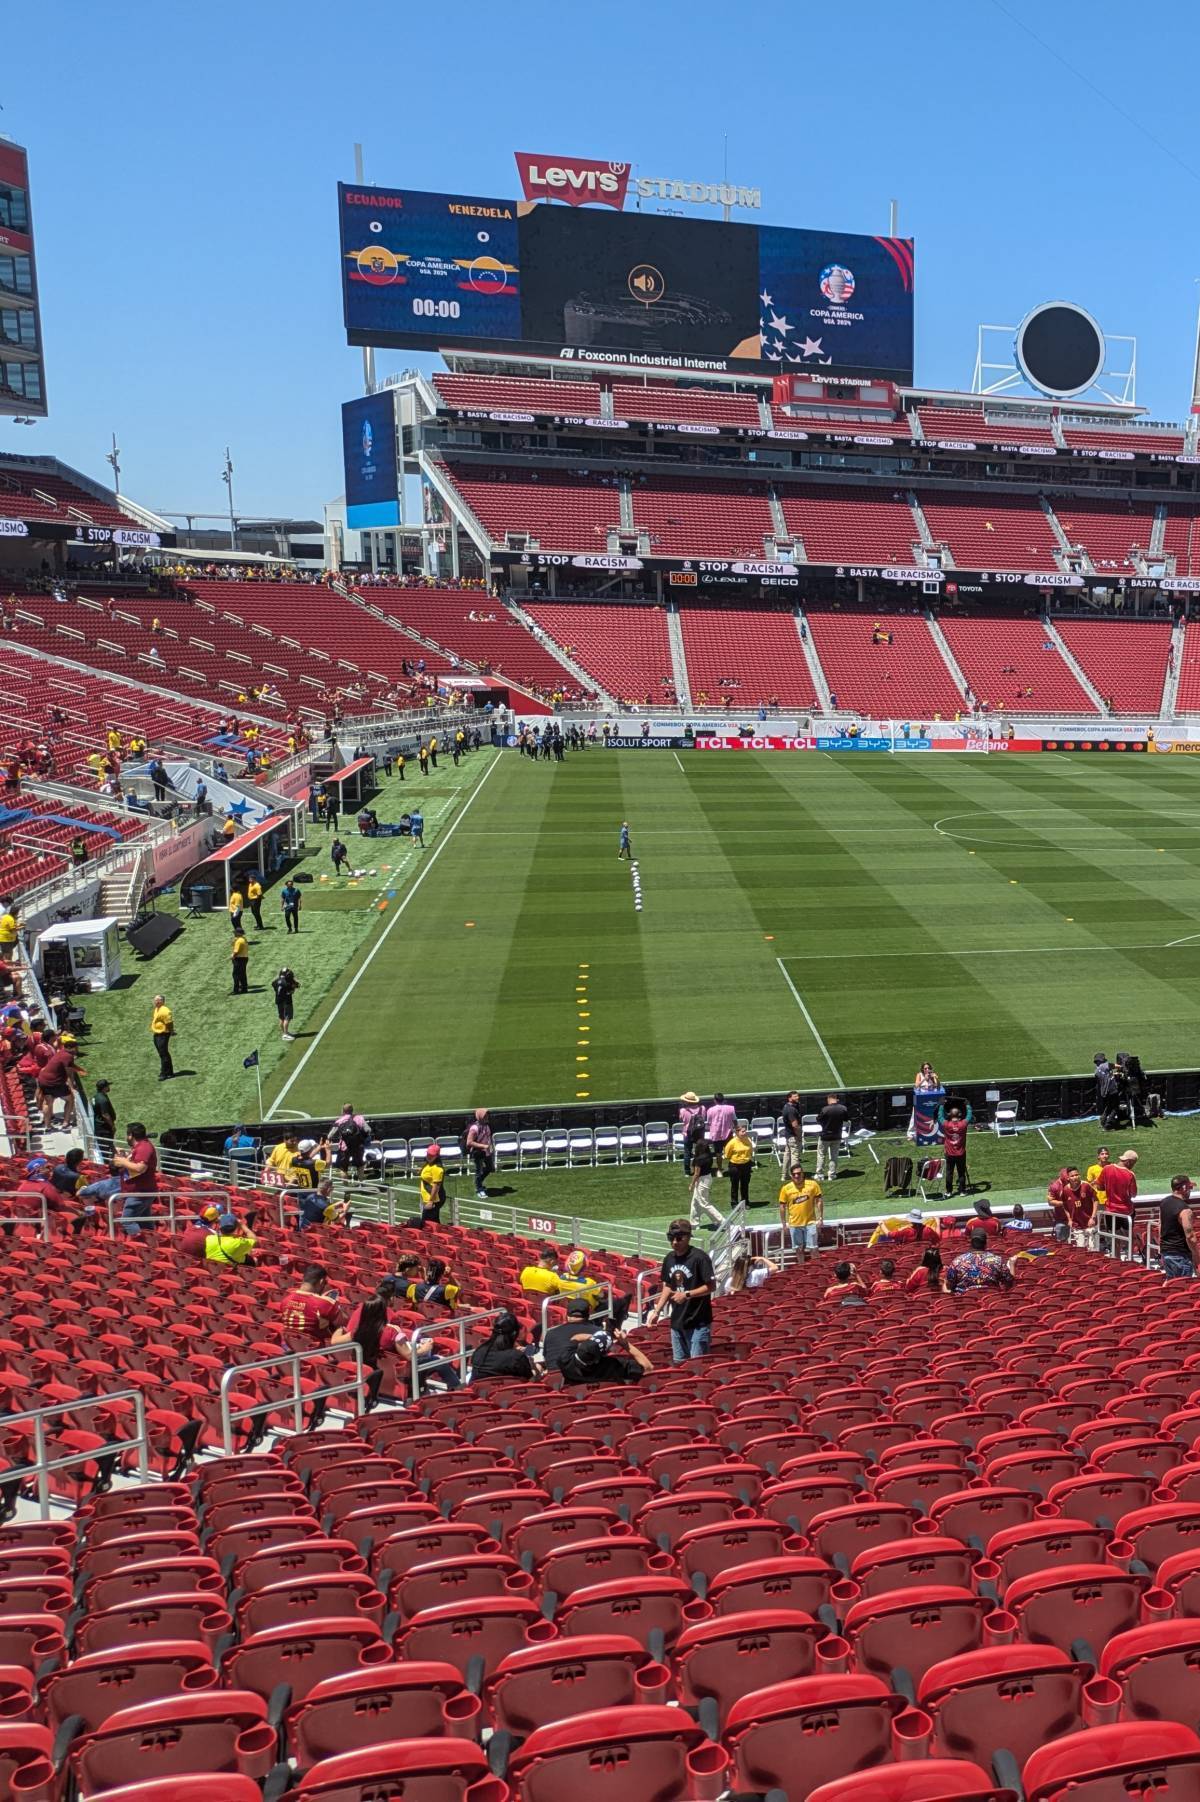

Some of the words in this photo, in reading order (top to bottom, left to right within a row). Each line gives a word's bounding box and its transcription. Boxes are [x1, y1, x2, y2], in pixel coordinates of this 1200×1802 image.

[529, 165, 619, 192] Levi's
[638, 178, 761, 209] STADIUM
[346, 193, 403, 208] ECUADOR
[448, 204, 512, 220] VENEZUELA
[406, 260, 426, 268] COPA
[427, 262, 460, 271] AMERICA
[413, 298, 460, 319] 00:00
[810, 309, 830, 317] COPA
[831, 311, 864, 320] AMERICA
[578, 349, 627, 362] Foxconn
[630, 353, 682, 367] Industrial
[684, 357, 726, 370] Internet
[840, 378, 872, 387] STADIUM
[88, 528, 110, 540] STOP
[121, 532, 150, 544] RACISM
[538, 555, 569, 565] STOP
[585, 557, 628, 567] RACISM
[698, 562, 728, 572] STOP
[743, 564, 784, 574] RACISM
[850, 569, 878, 577] BASTA
[887, 570, 900, 578] DE
[900, 570, 941, 580] RACISMO
[995, 574, 1021, 582] STOP
[1035, 576, 1072, 585] RACISM
[761, 578, 798, 586] GEICO
[1131, 579, 1157, 588] BASTA
[642, 739, 672, 747] SPORT
[696, 737, 732, 749] TCL
[740, 738, 774, 749] TCL
[782, 738, 816, 749] TCL
[966, 740, 1008, 750] Betano
[262, 1173, 283, 1186] 131
[1075, 1200, 1082, 1208] 10
[531, 1219, 552, 1232] 130
